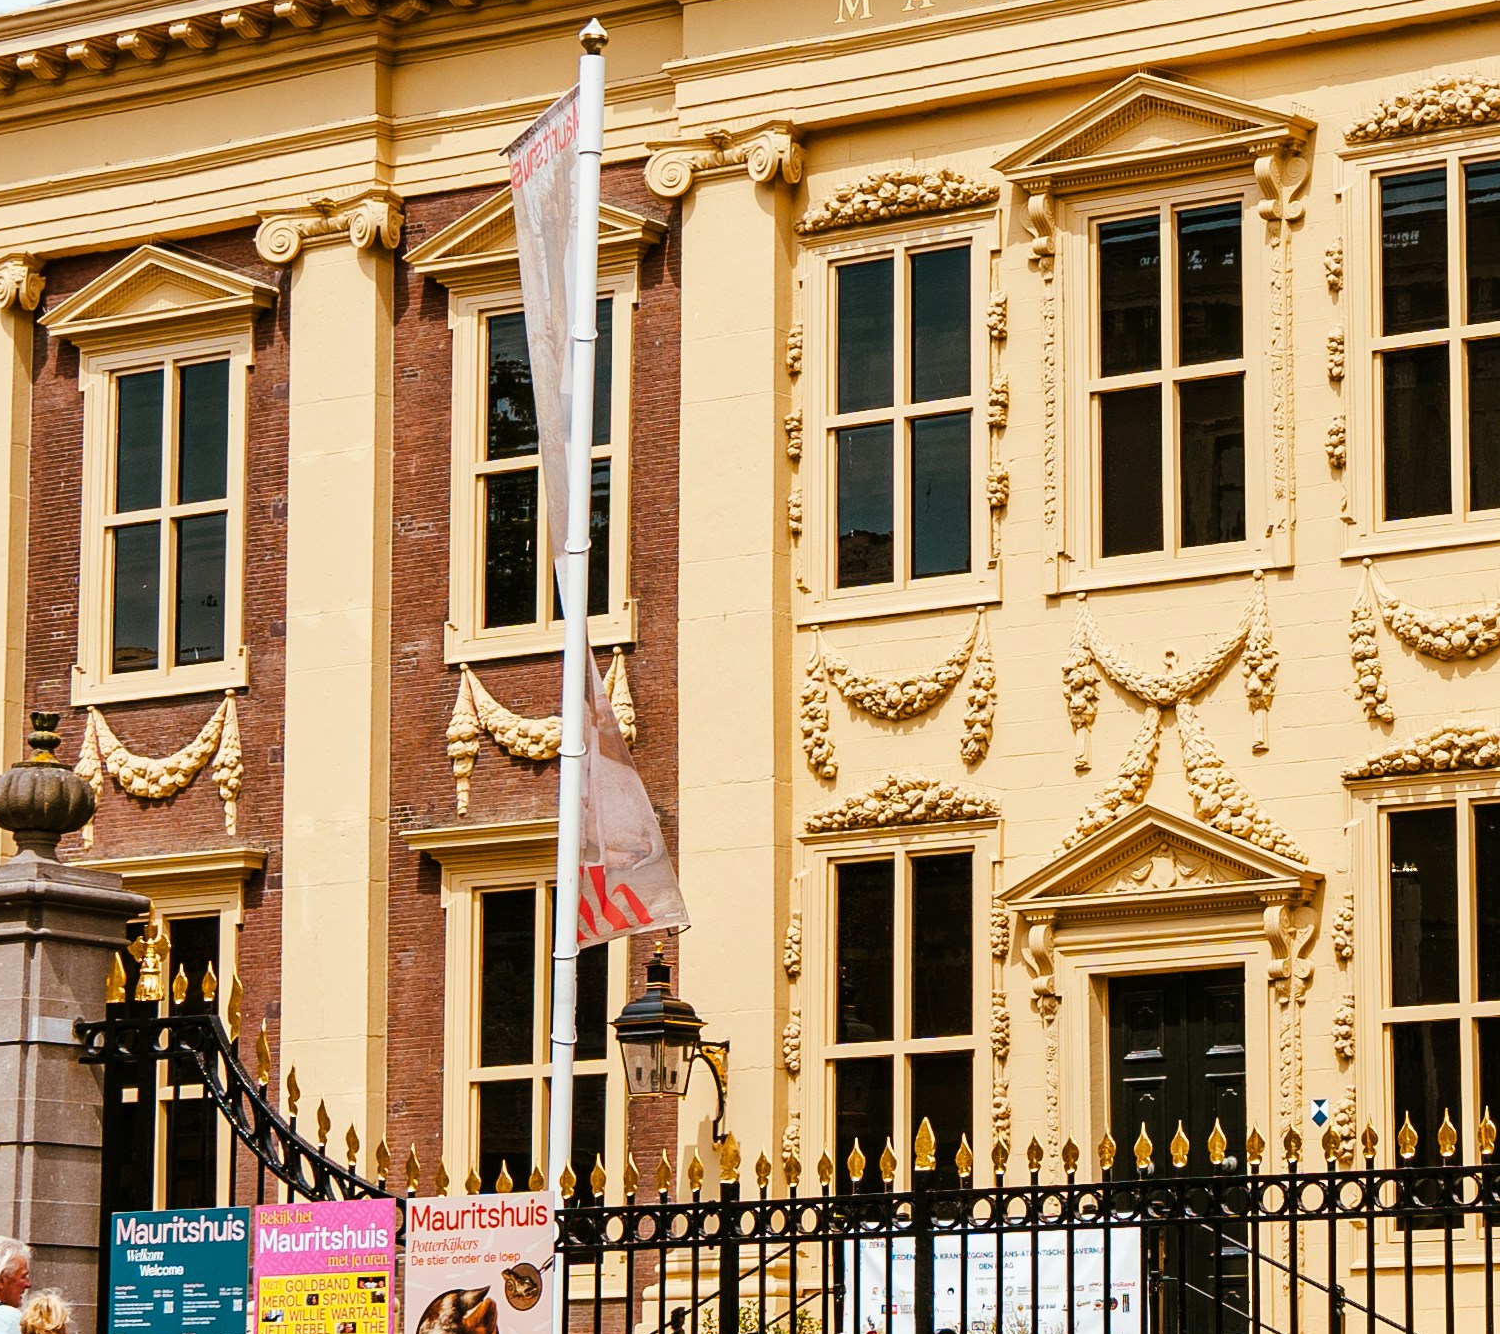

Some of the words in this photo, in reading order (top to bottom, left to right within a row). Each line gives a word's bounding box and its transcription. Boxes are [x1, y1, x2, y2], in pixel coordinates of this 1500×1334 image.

[260, 1210, 293, 1226] Bekijk
[295, 1209, 313, 1223] het
[411, 1199, 548, 1232] Mauritshuis
[116, 1214, 245, 1245] Mauritshuis
[260, 1223, 388, 1254] Mauritshuis
[411, 1234, 479, 1254] PotterKijkers
[127, 1248, 164, 1262] Welkom
[327, 1254, 349, 1266] met
[351, 1252, 361, 1269] je
[363, 1253, 390, 1265] oren.
[411, 1256, 424, 1266] De
[427, 1254, 449, 1265] stier
[452, 1254, 480, 1265] onder
[484, 1252, 496, 1262] de
[499, 1251, 521, 1264] loep
[139, 1264, 184, 1277] Welcome
[285, 1278, 350, 1292] GOLDBAND
[263, 1293, 301, 1307] MEROL
[323, 1291, 366, 1305] SPINVIS
[289, 1308, 326, 1321] WILLIE
[331, 1305, 385, 1320] WARTAAL
[363, 1321, 385, 1333] THE
